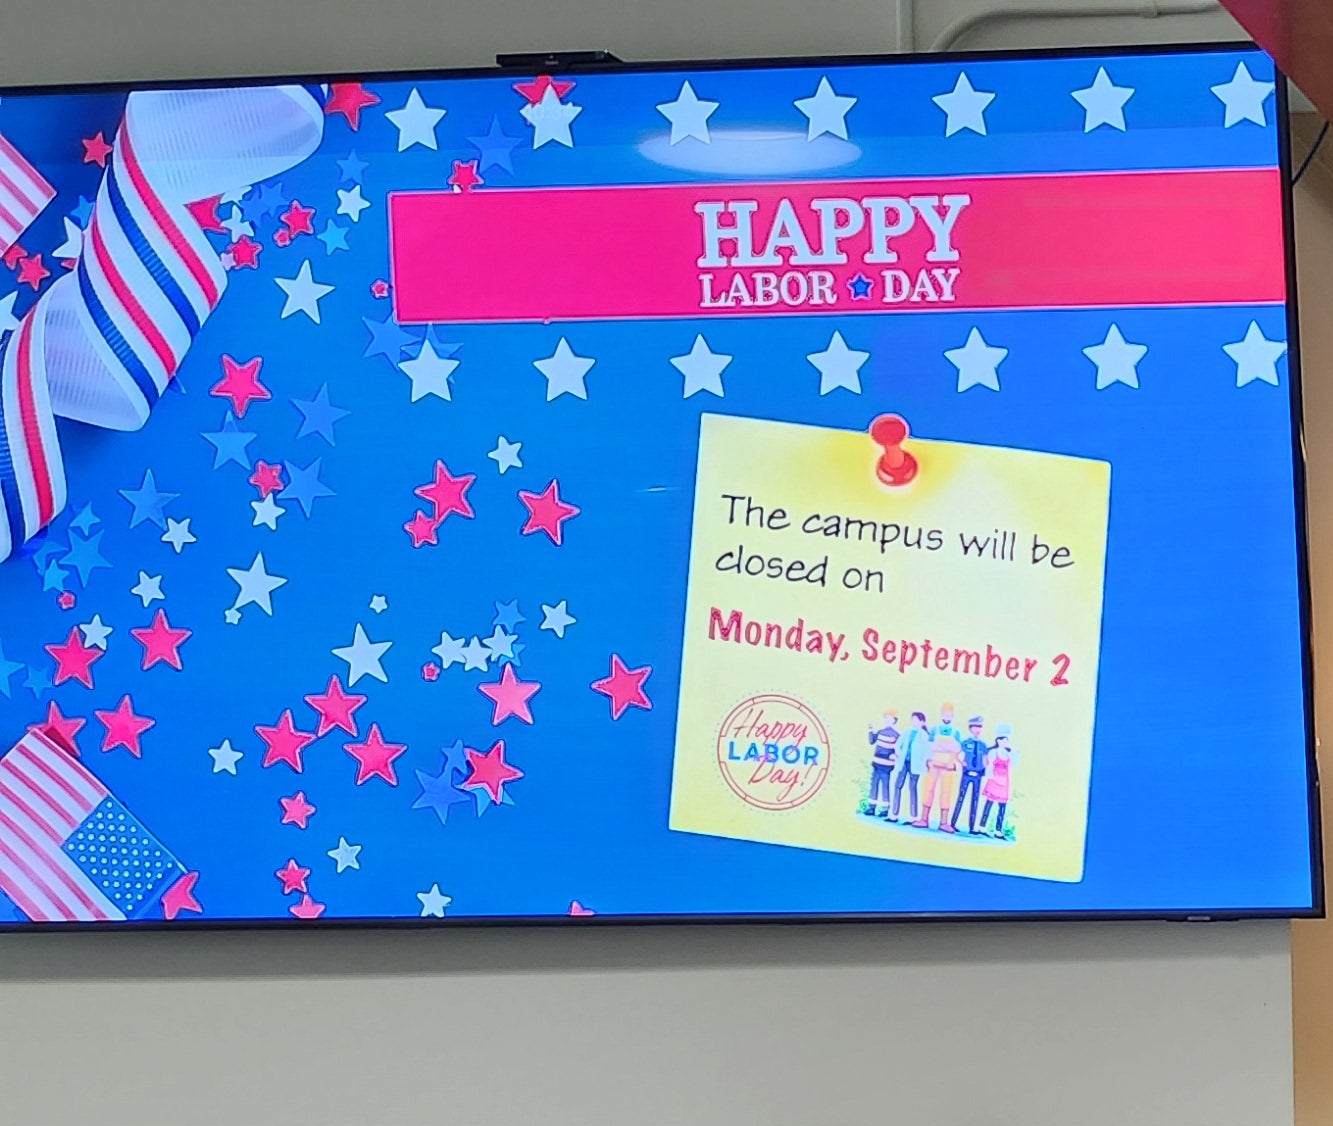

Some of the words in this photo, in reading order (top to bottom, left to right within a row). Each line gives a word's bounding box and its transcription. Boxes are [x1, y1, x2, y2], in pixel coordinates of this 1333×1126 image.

[694, 194, 971, 268] HAPPY
[698, 270, 838, 308] LABOR
[880, 267, 961, 303] DAY
[721, 494, 791, 531] The
[801, 512, 944, 554] campus
[959, 528, 1017, 562] will
[1031, 534, 1076, 569] be
[714, 545, 829, 588] closed
[842, 567, 885, 594] on
[708, 607, 850, 662] Monday,
[860, 627, 1038, 683] September
[1049, 653, 1072, 687] 2
[728, 741, 820, 766] LABOR
[733, 708, 808, 756] Happy
[747, 754, 817, 802] Day!
